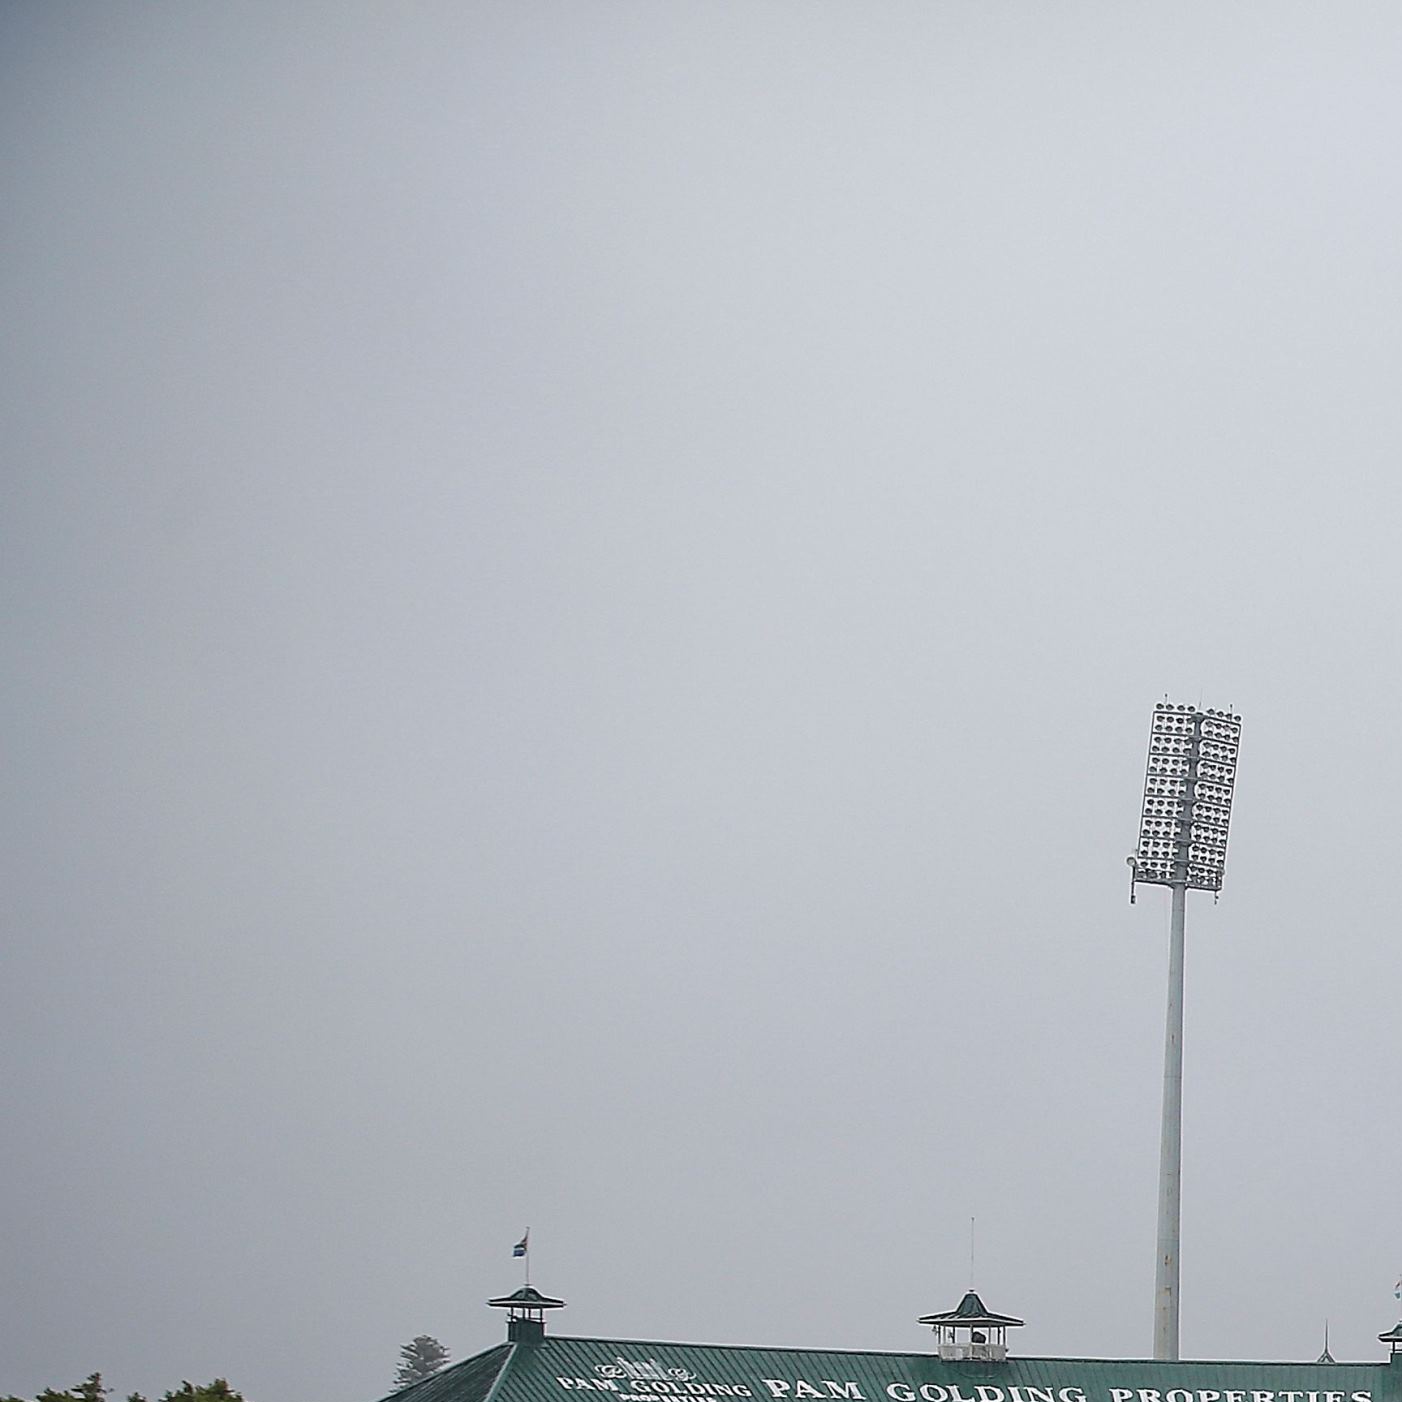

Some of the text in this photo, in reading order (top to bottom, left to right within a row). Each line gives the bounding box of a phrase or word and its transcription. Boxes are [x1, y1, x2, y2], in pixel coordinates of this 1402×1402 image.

[556, 1376, 752, 1397] PAM GOLDING
[762, 1379, 866, 1400] PAM
